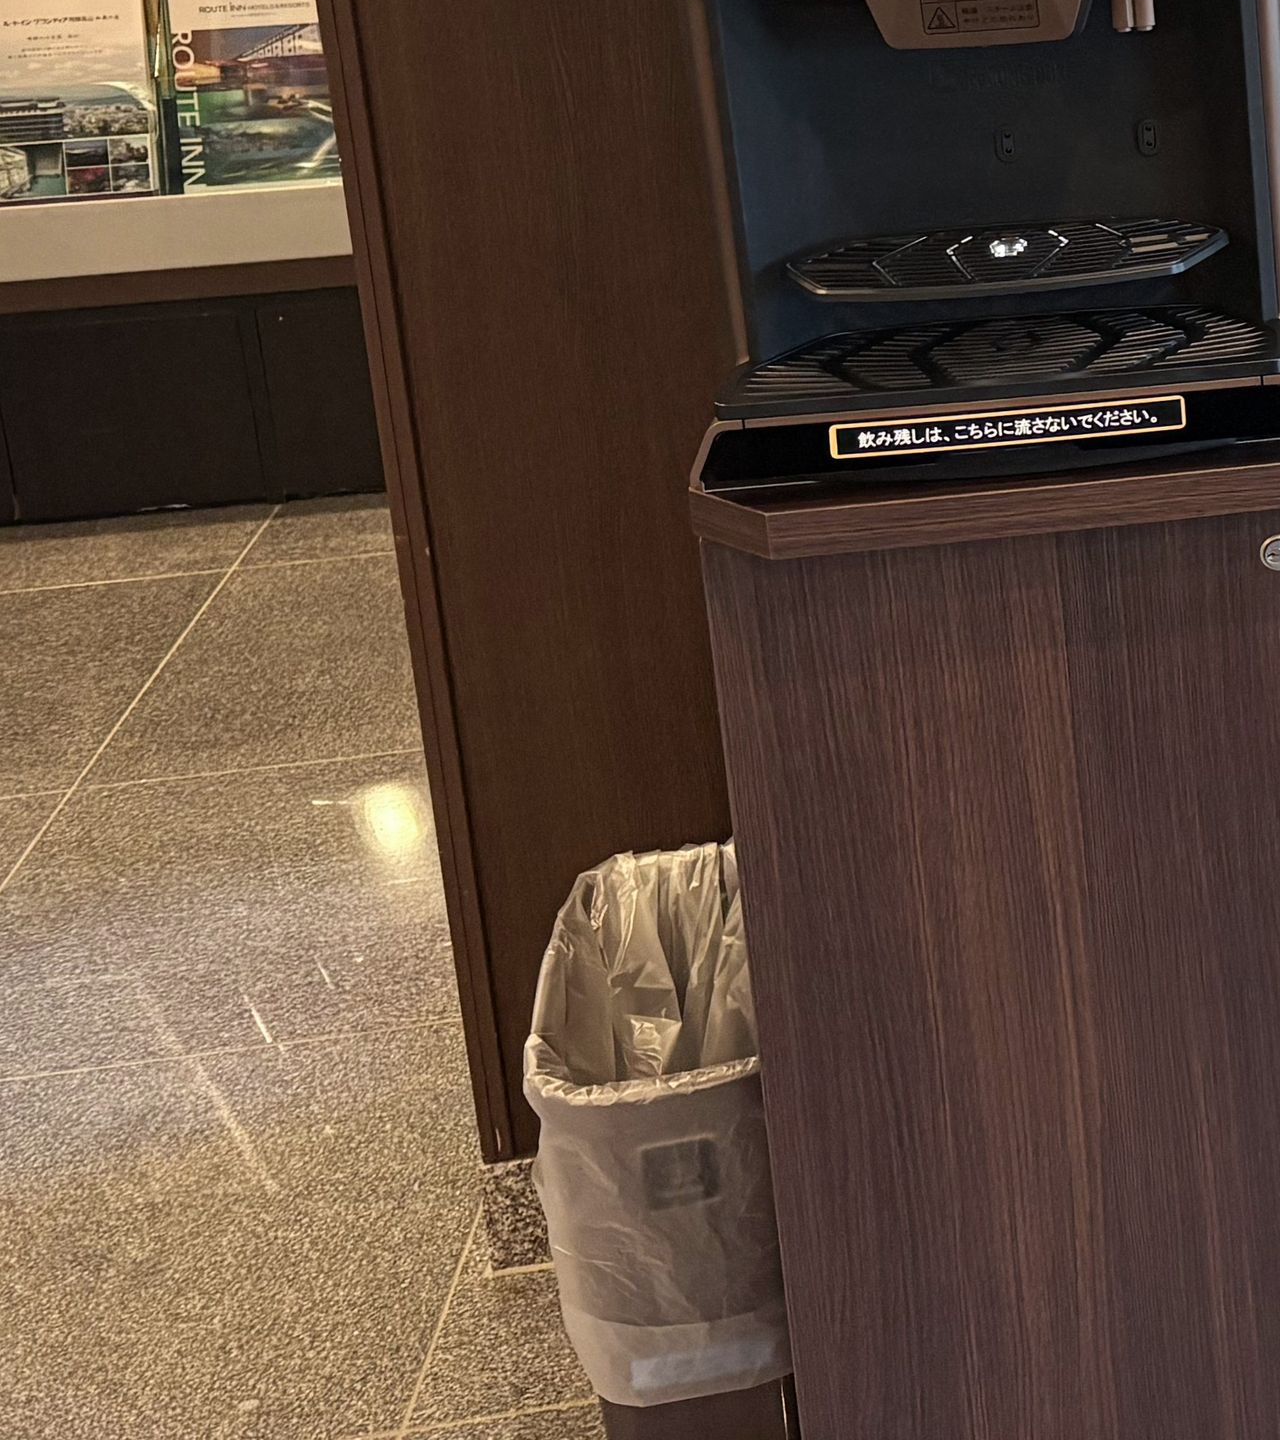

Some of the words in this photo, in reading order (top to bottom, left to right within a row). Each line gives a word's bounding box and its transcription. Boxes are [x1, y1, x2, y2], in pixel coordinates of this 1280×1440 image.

[198, 5, 227, 14] ROUTE
[172, 29, 201, 127] ROUTE
[179, 137, 208, 188] INN
[857, 407, 1159, 450] 飲み残しは、こちらに流さないでください。
